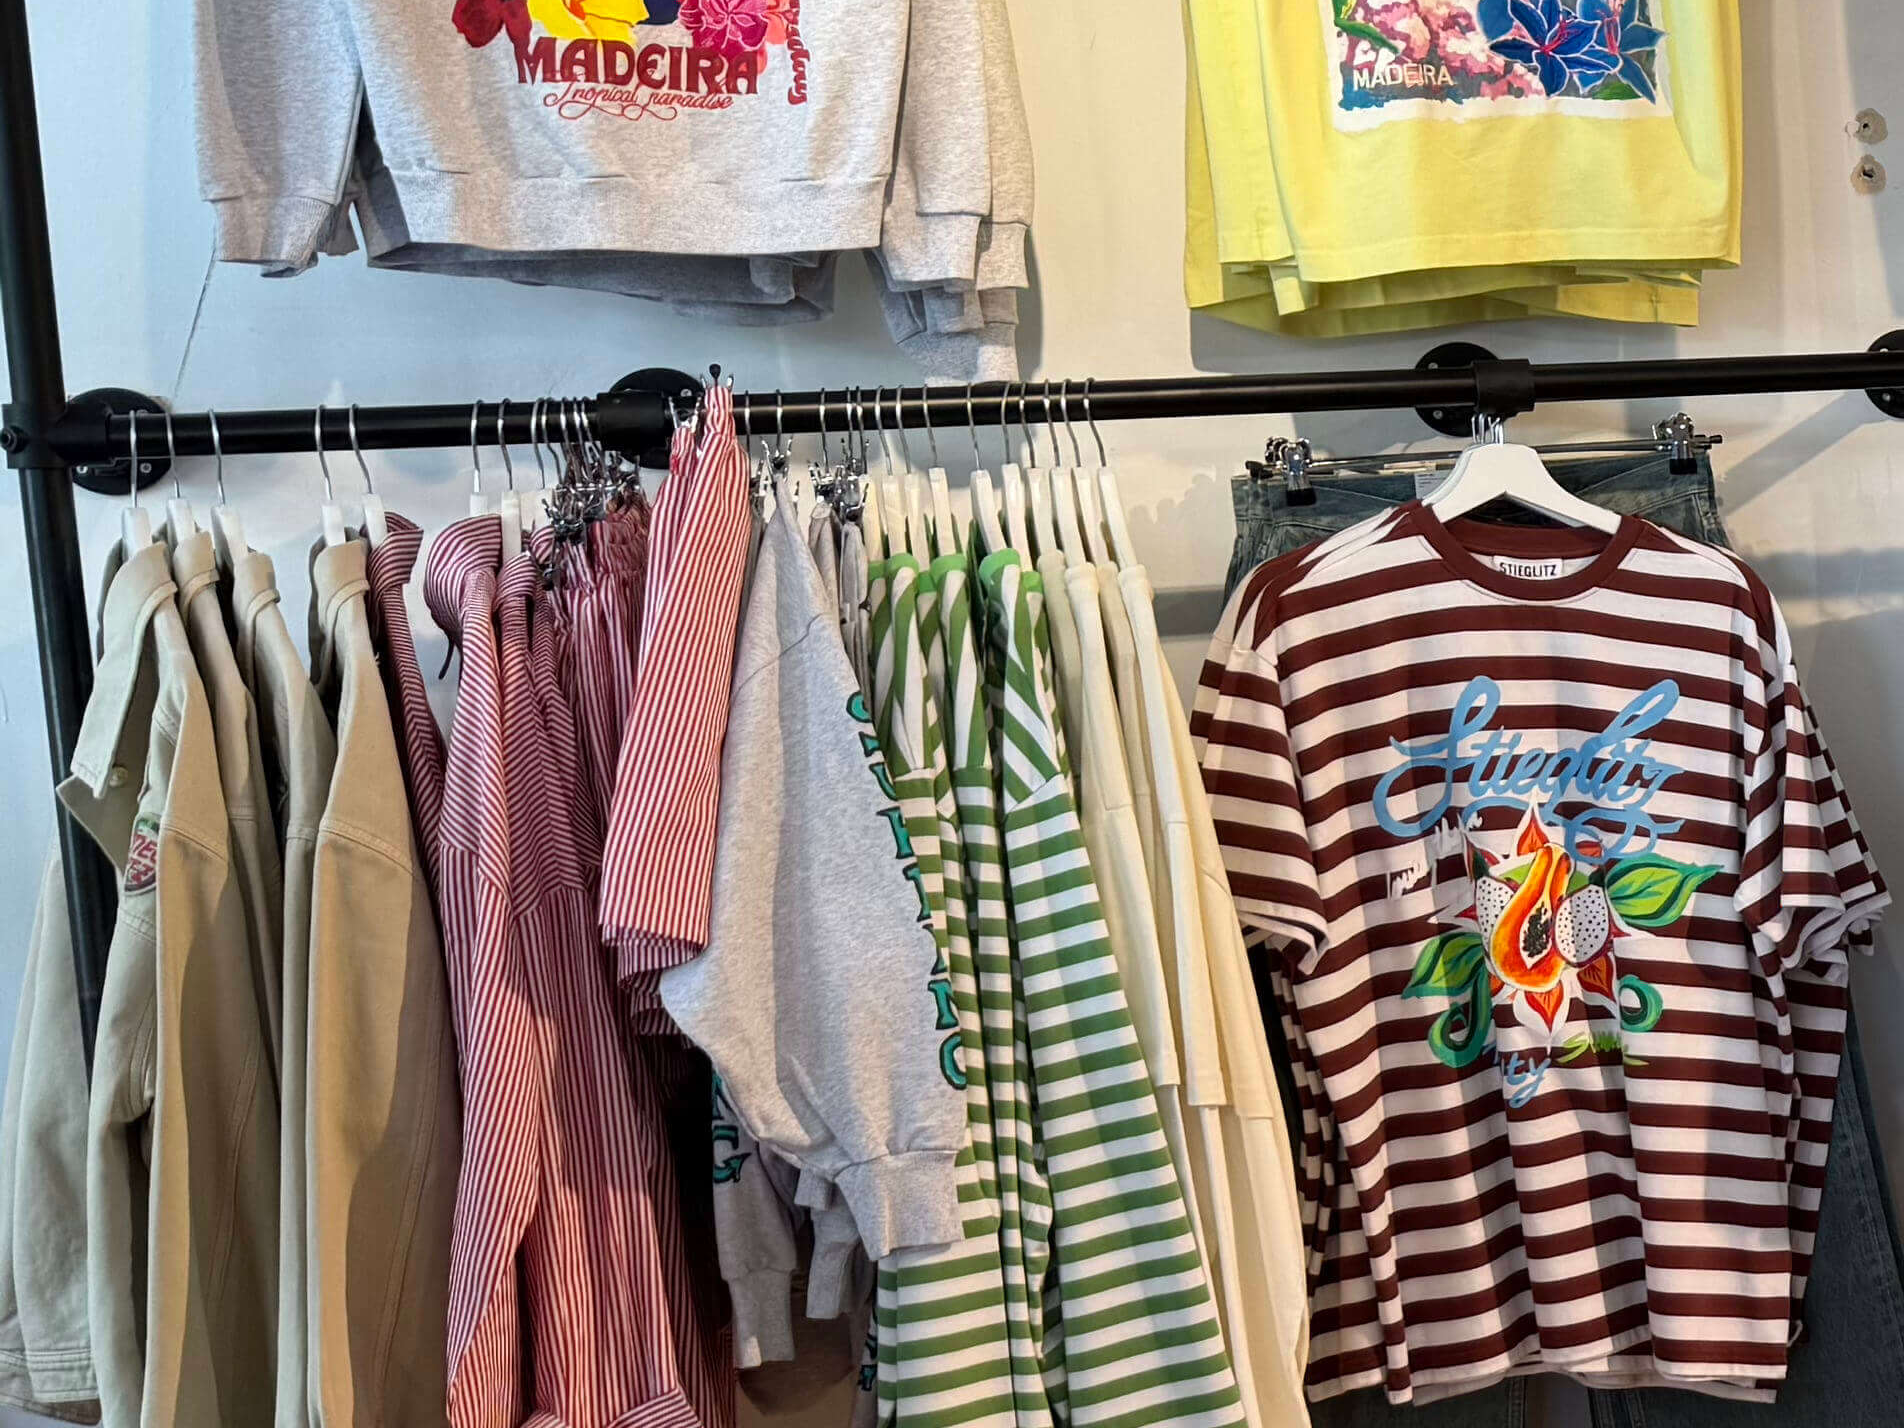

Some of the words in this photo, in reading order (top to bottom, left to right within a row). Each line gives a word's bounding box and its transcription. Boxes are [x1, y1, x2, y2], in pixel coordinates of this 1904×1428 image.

[517, 36, 758, 95] MADEIRA
[1352, 61, 1456, 91] MADEIRA
[1372, 675, 1686, 864] Stieglitz
